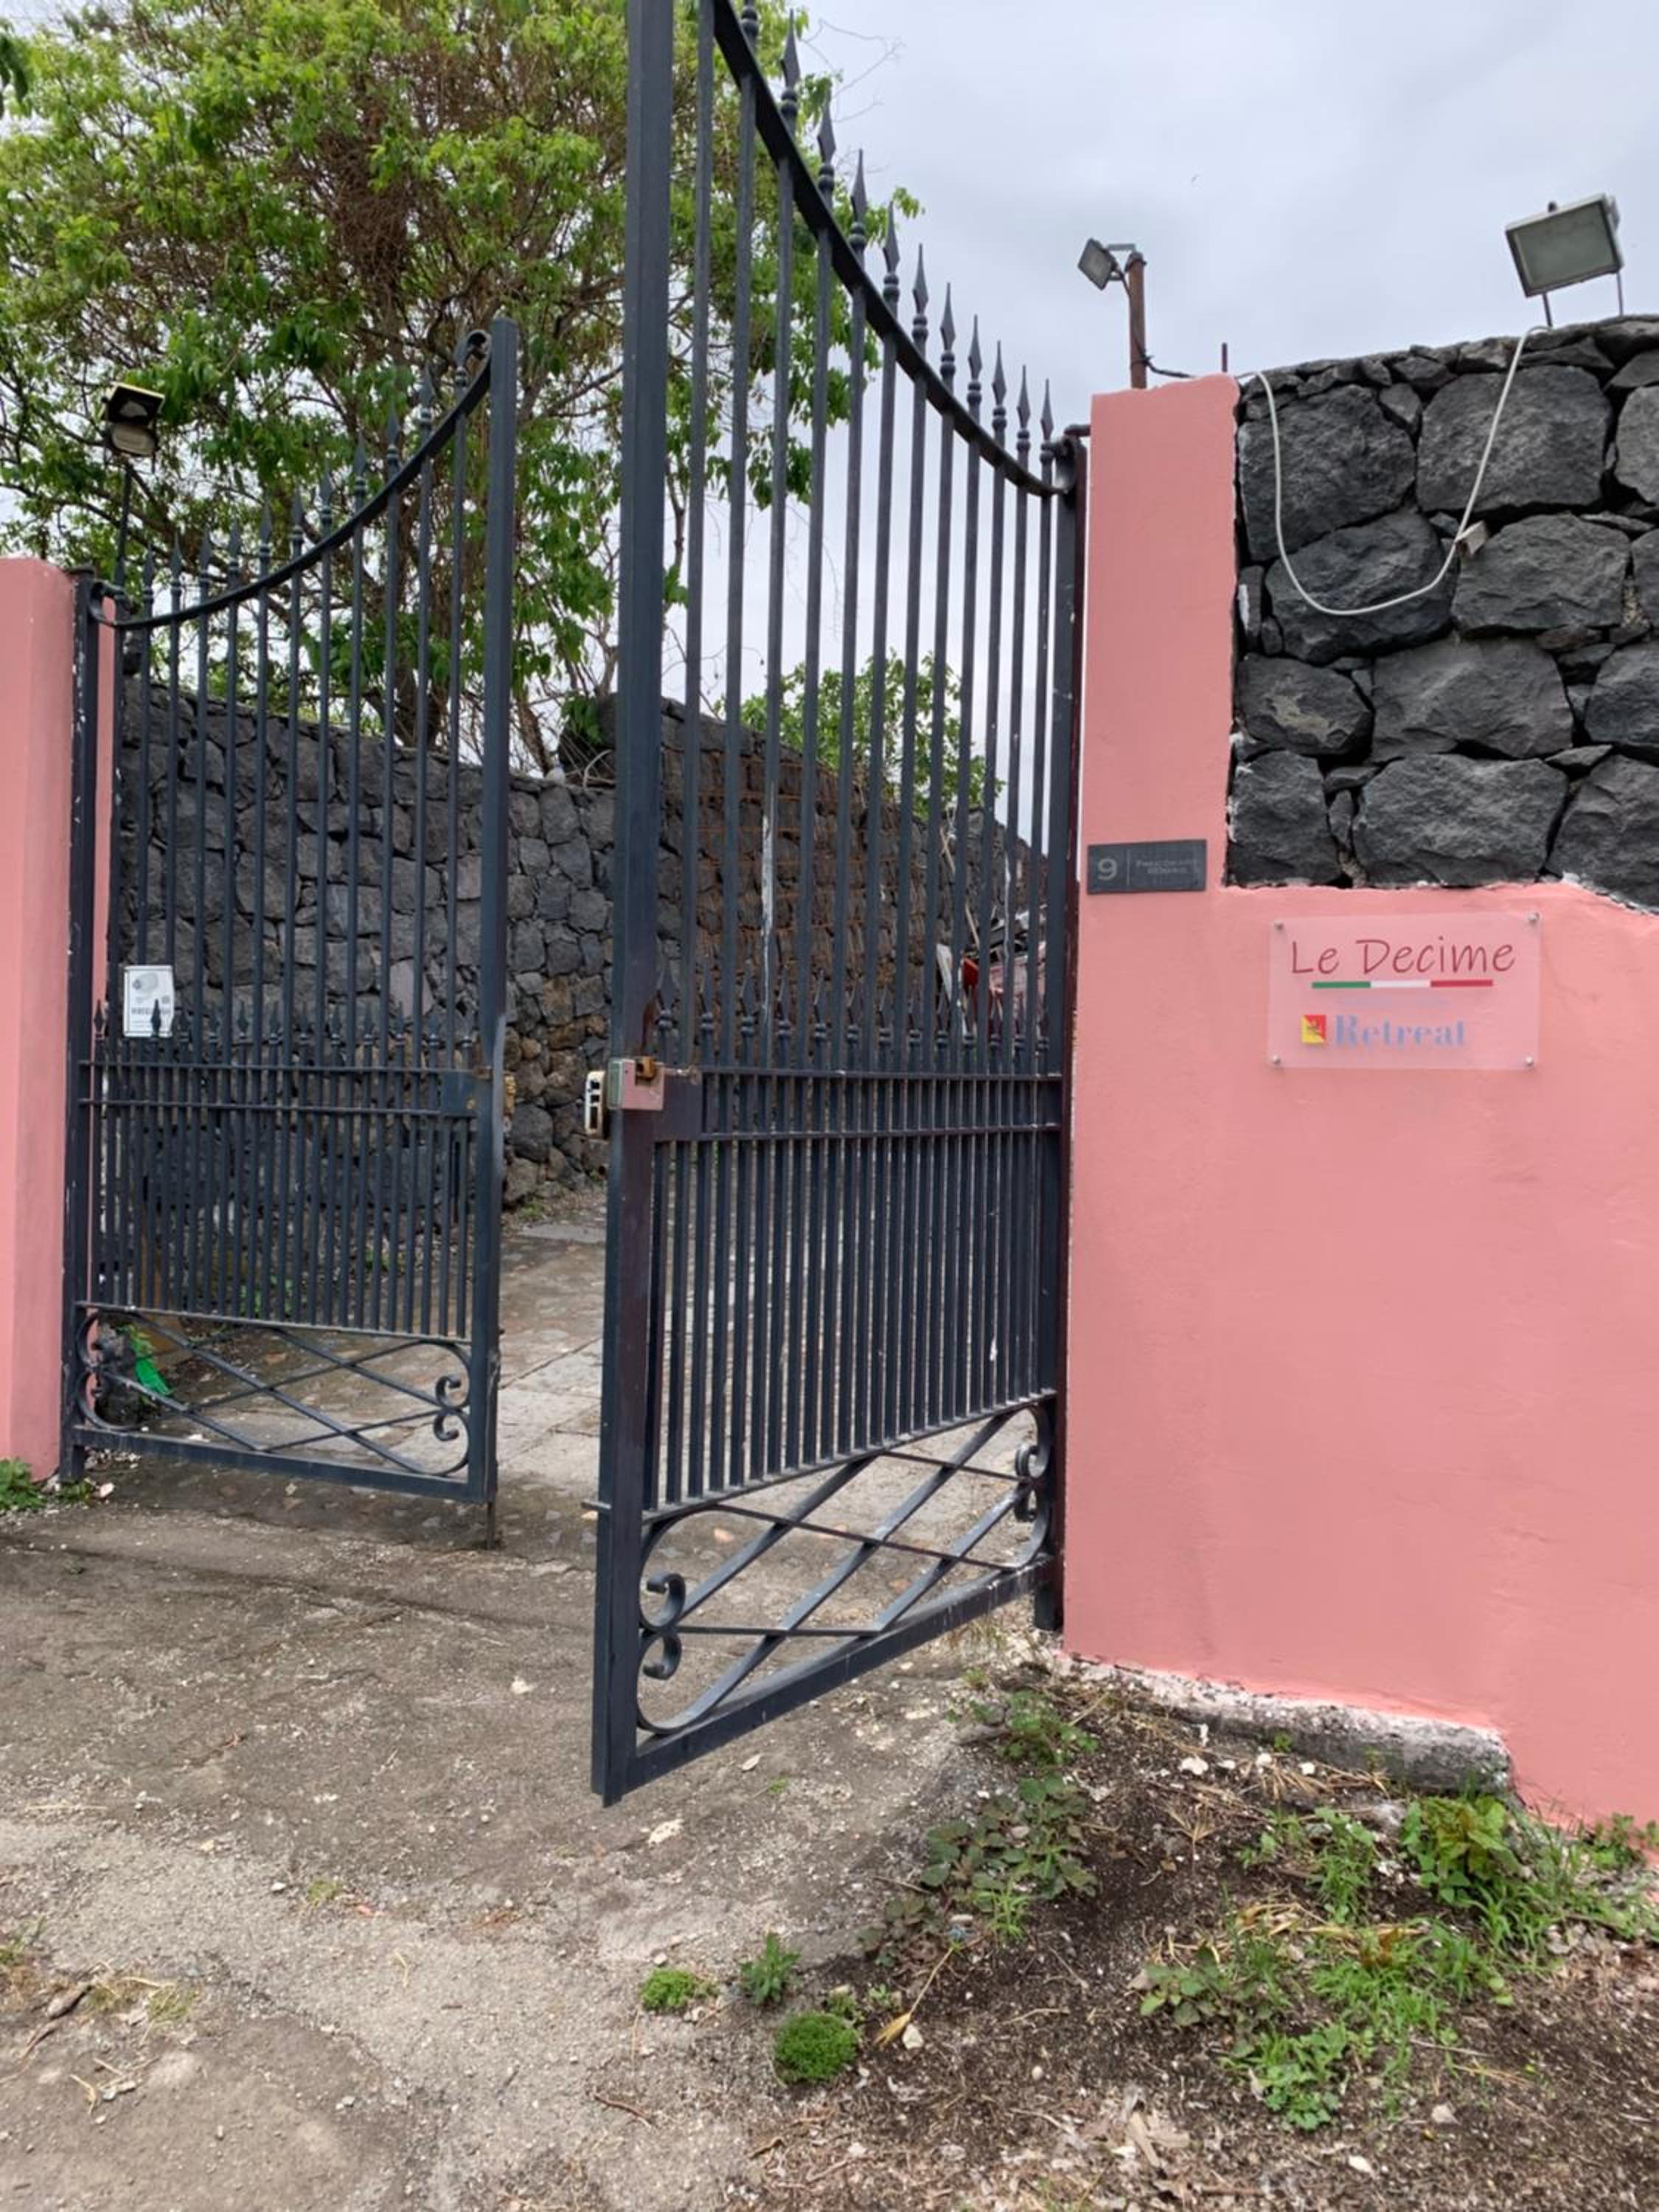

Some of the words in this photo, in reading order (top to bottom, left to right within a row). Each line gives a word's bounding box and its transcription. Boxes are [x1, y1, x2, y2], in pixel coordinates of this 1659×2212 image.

[1097, 858, 1118, 880] 9
[1292, 940, 1339, 975] Le
[1356, 936, 1516, 975] Decime
[1334, 1015, 1464, 1046] Retreat
